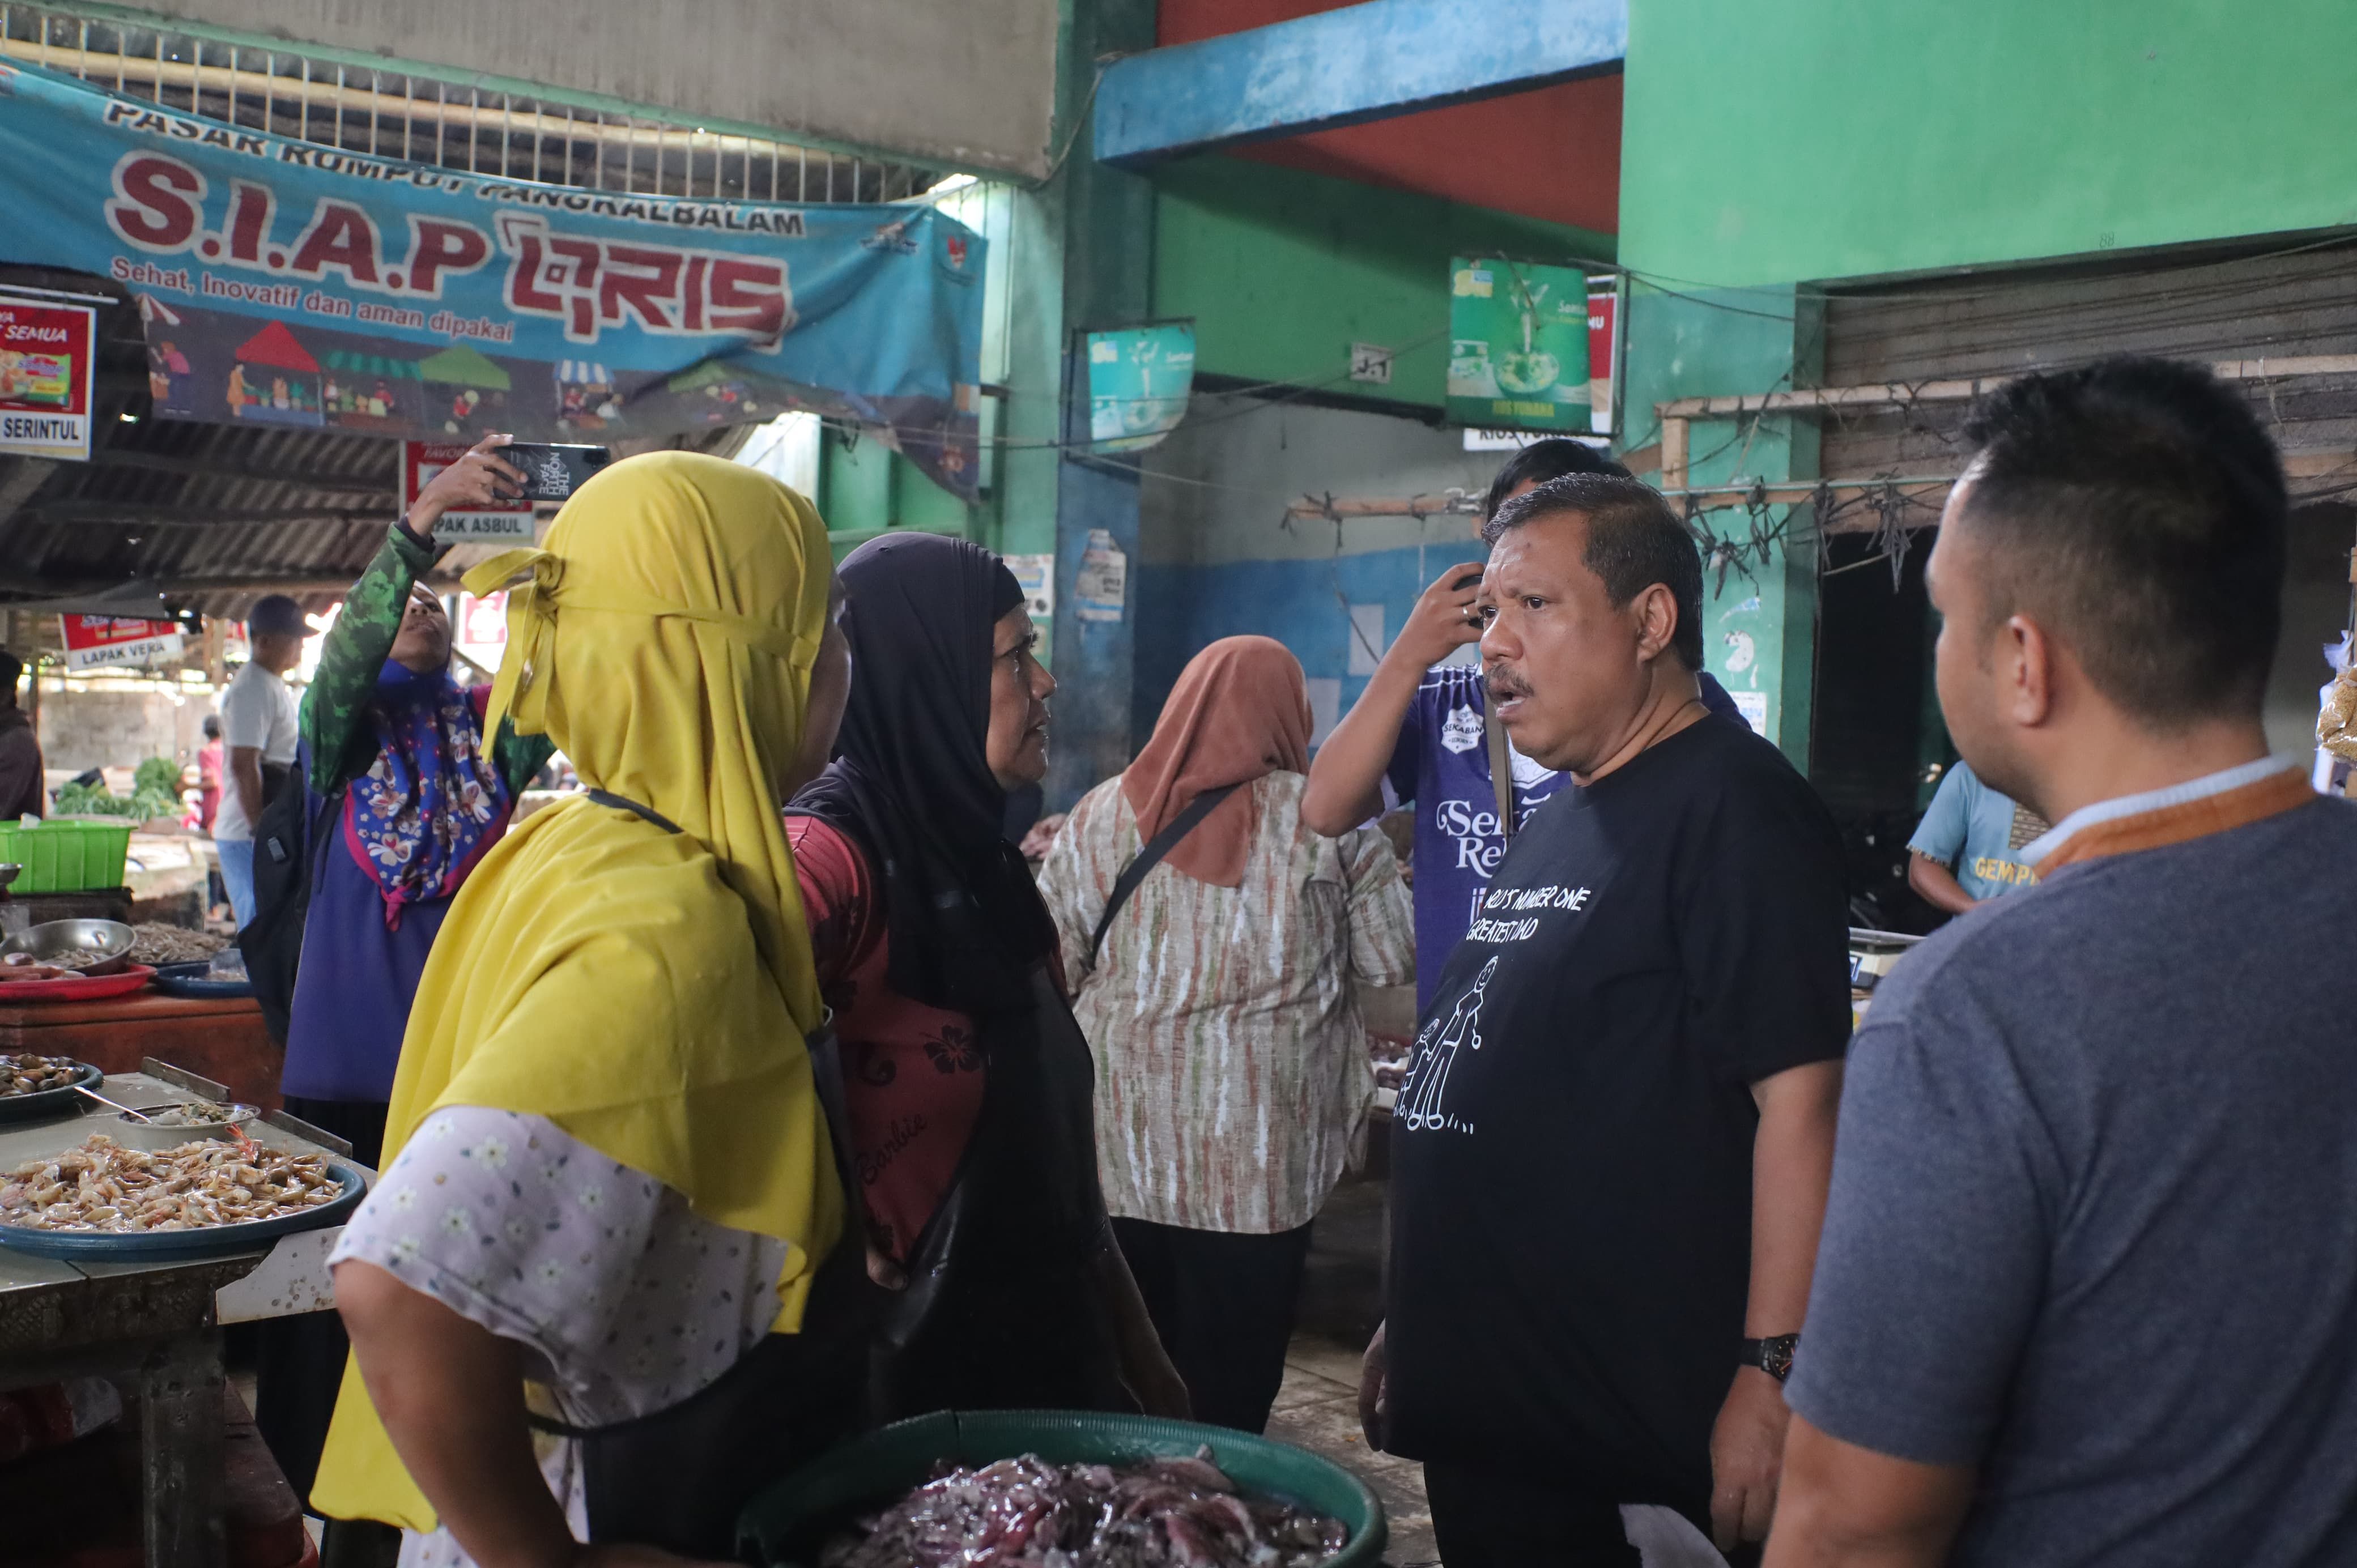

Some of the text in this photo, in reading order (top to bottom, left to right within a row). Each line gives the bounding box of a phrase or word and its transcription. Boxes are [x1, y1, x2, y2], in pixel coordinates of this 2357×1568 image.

[112, 257, 513, 341] Sehat, Inovatif dan aman dipakai
[4, 325, 67, 343] SEMUA
[3, 416, 79, 440] SERINTUL
[559, 471, 569, 496] THE
[433, 517, 522, 533] PAK ASBUL
[82, 646, 125, 664] LAPAK
[1443, 723, 1483, 734] SEKABAN
[1511, 885, 1558, 911] NUMBER
[1553, 887, 1592, 911] ONE
[1466, 917, 1519, 943] GREATEST
